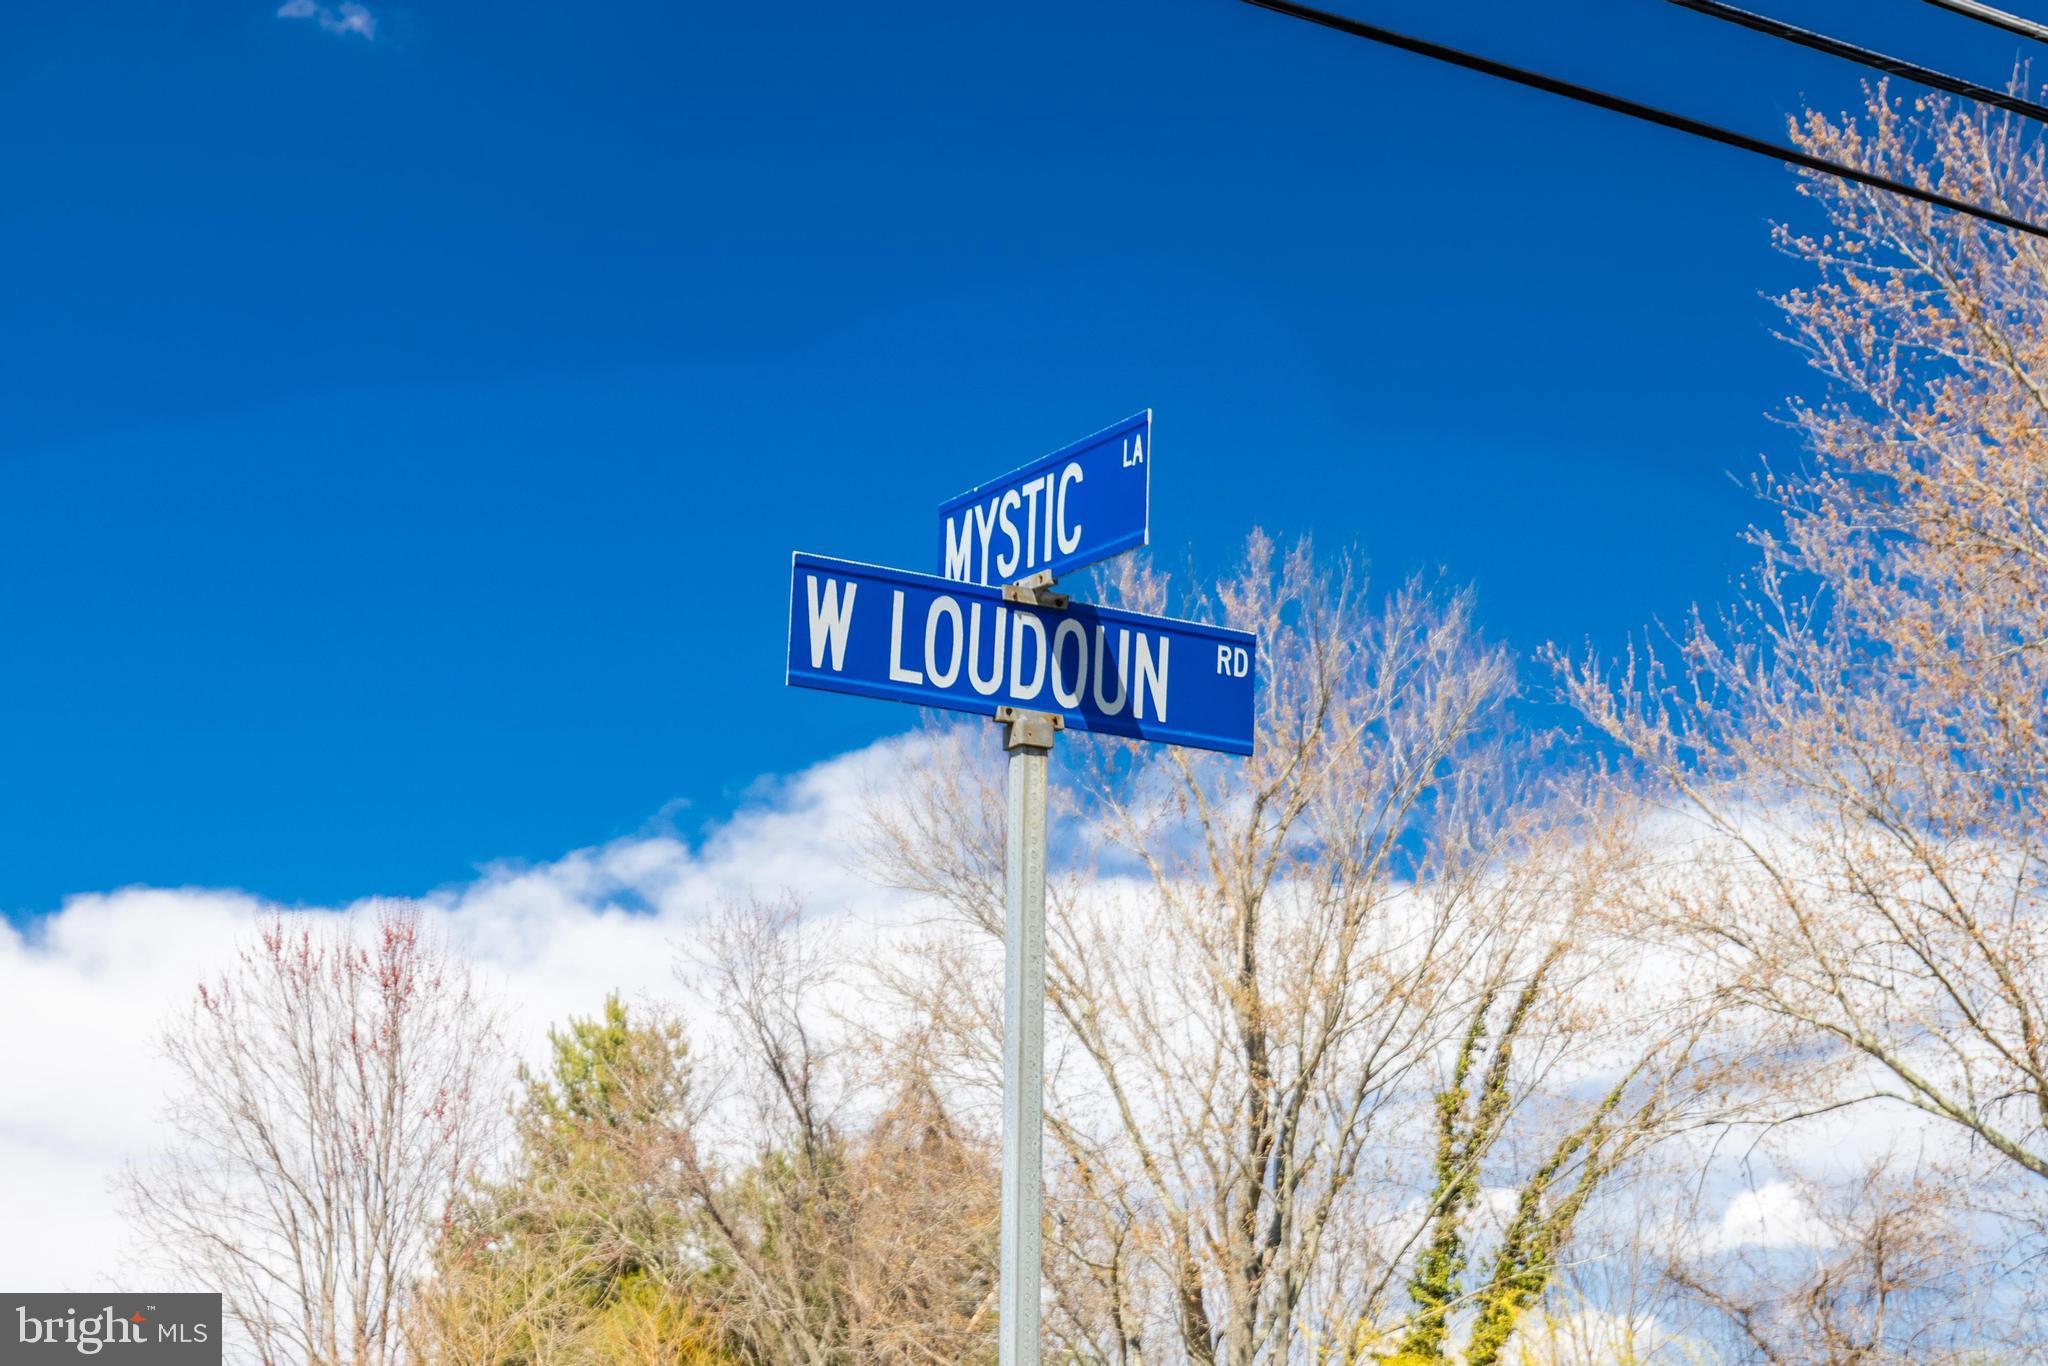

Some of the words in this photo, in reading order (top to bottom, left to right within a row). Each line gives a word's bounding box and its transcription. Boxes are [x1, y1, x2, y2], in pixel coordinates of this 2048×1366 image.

[945, 462, 1083, 586] MYSTIC
[1122, 434, 1144, 468] LA
[806, 575, 857, 672] W
[889, 589, 1170, 723] LOUDOUN
[1216, 645, 1249, 678] RD
